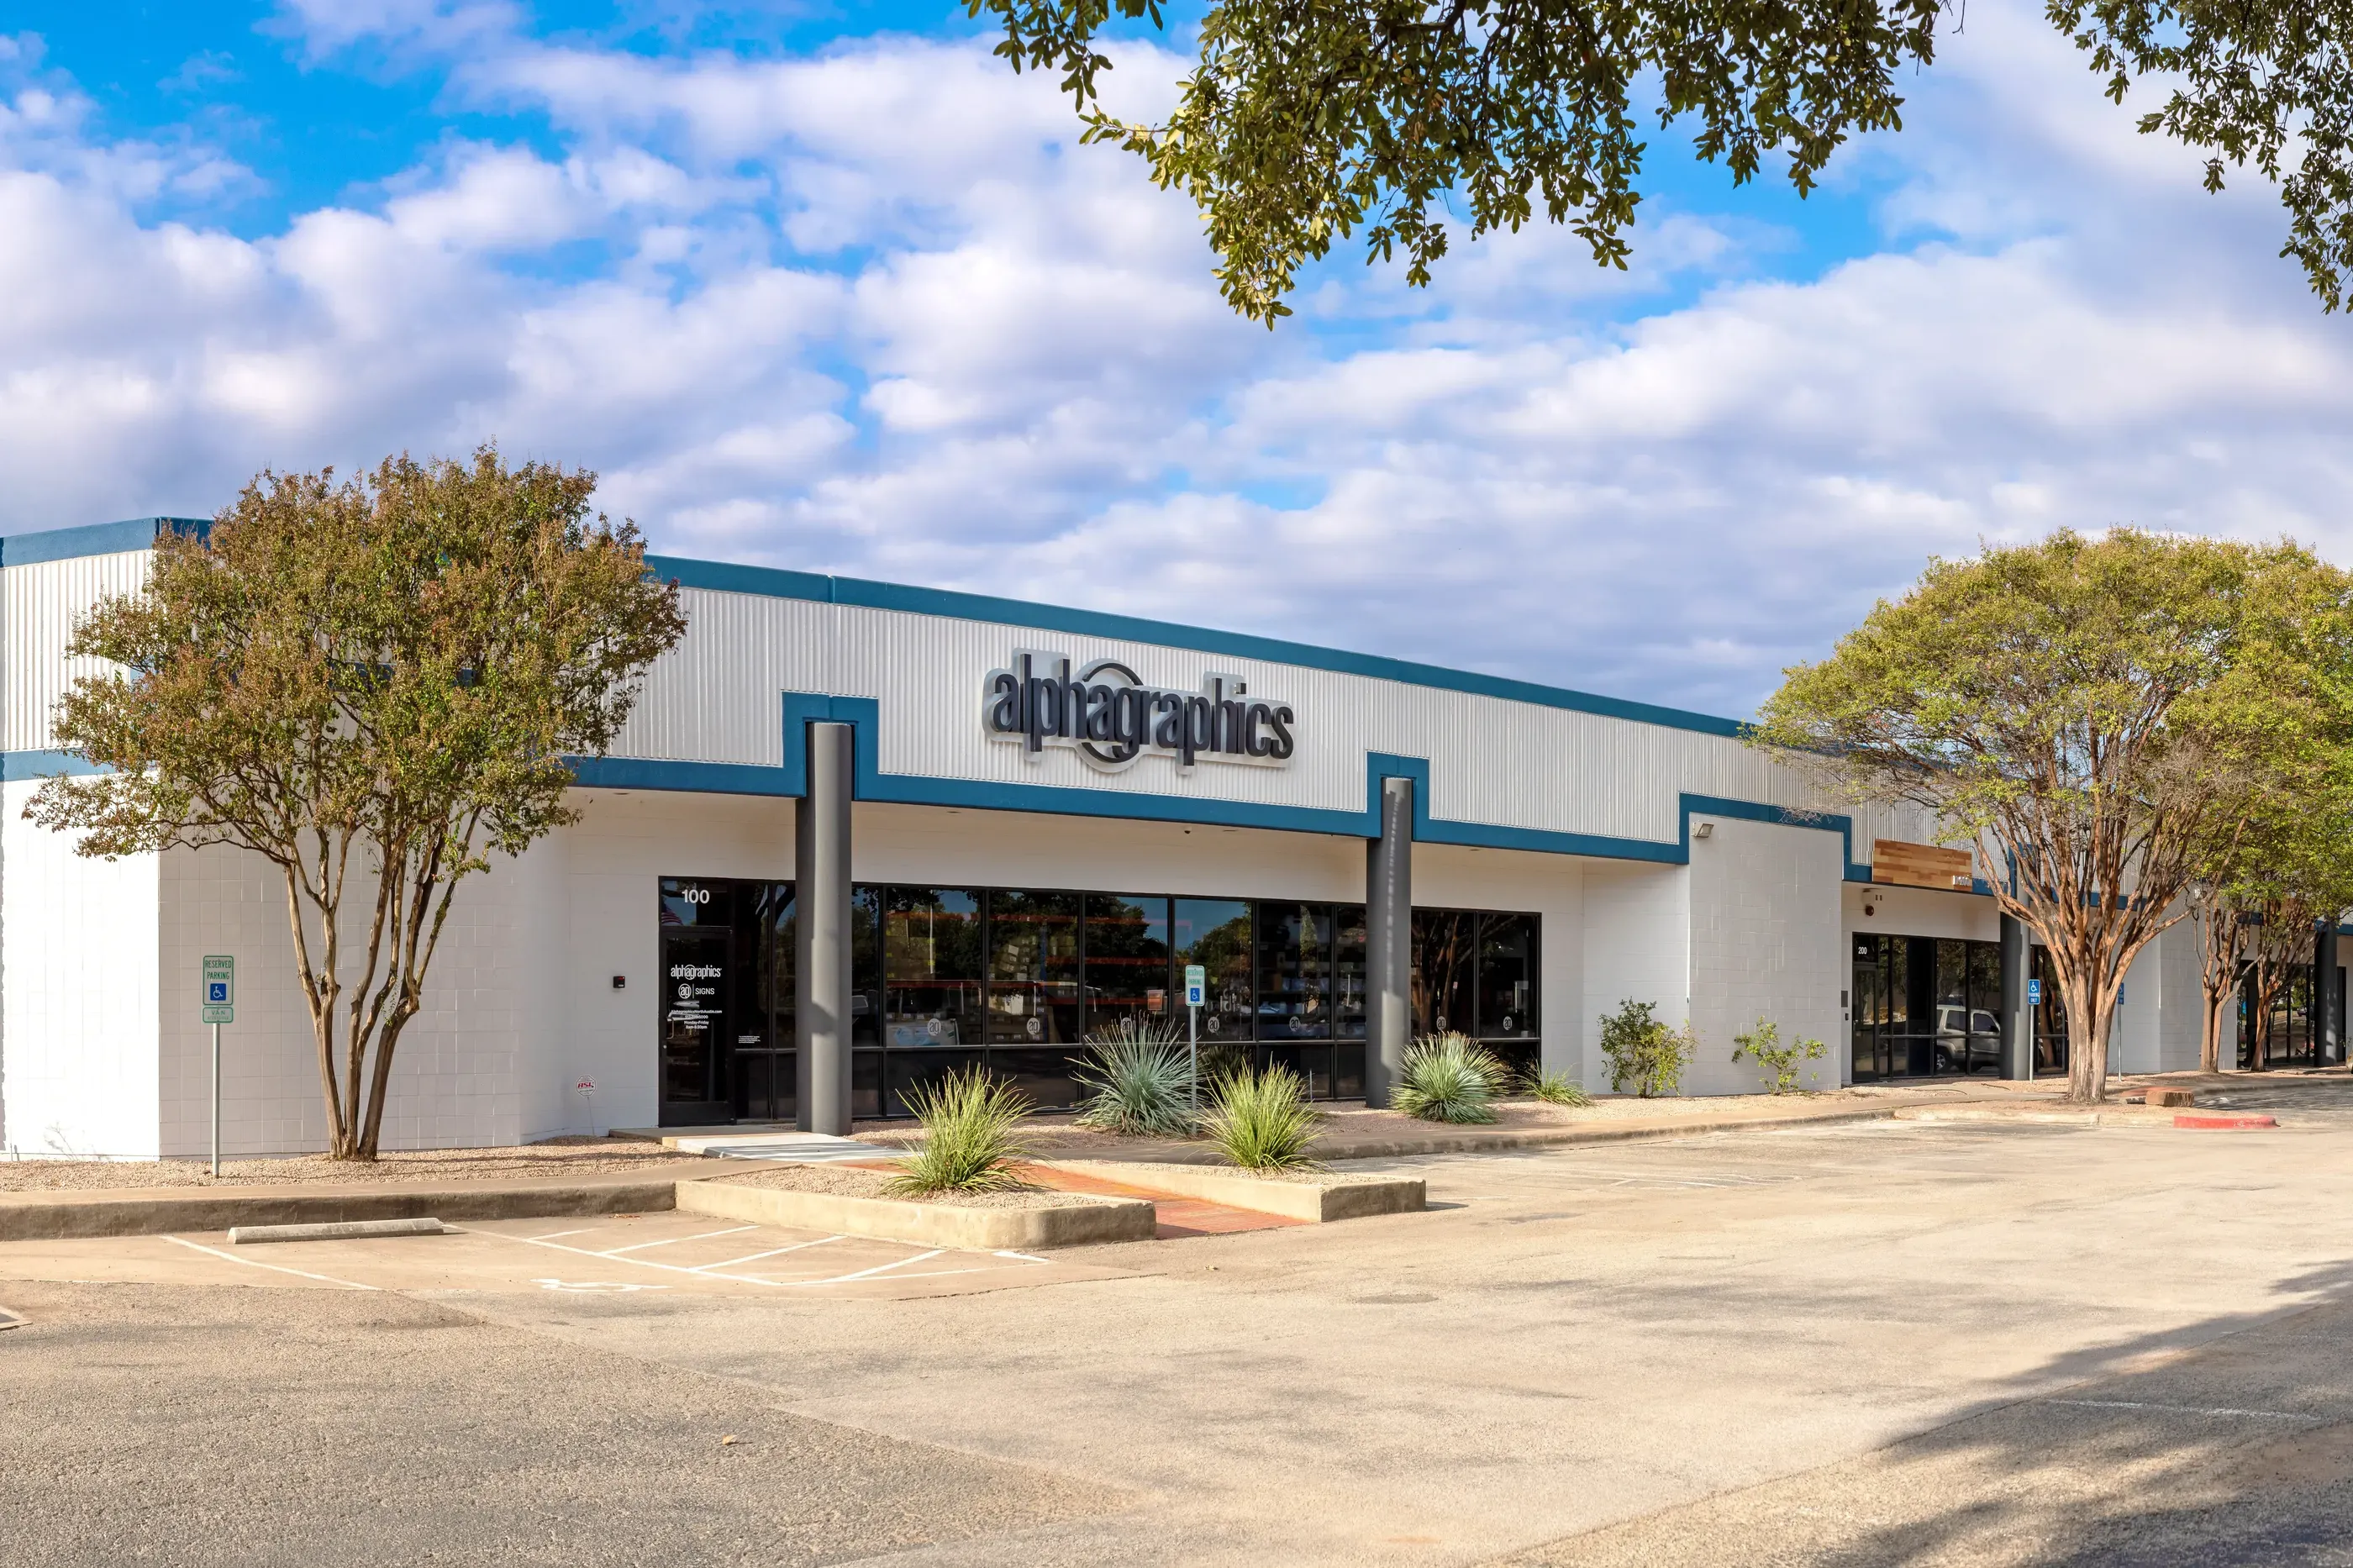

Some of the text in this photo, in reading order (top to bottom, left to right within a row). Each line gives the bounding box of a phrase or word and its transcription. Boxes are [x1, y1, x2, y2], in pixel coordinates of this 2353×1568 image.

[992, 652, 1294, 766] alphagraphics
[682, 889, 710, 904] 100
[1858, 946, 1867, 955] 200
[205, 960, 232, 969] RESERVED
[207, 971, 230, 980] PARKING
[671, 964, 722, 981] alphagraphics
